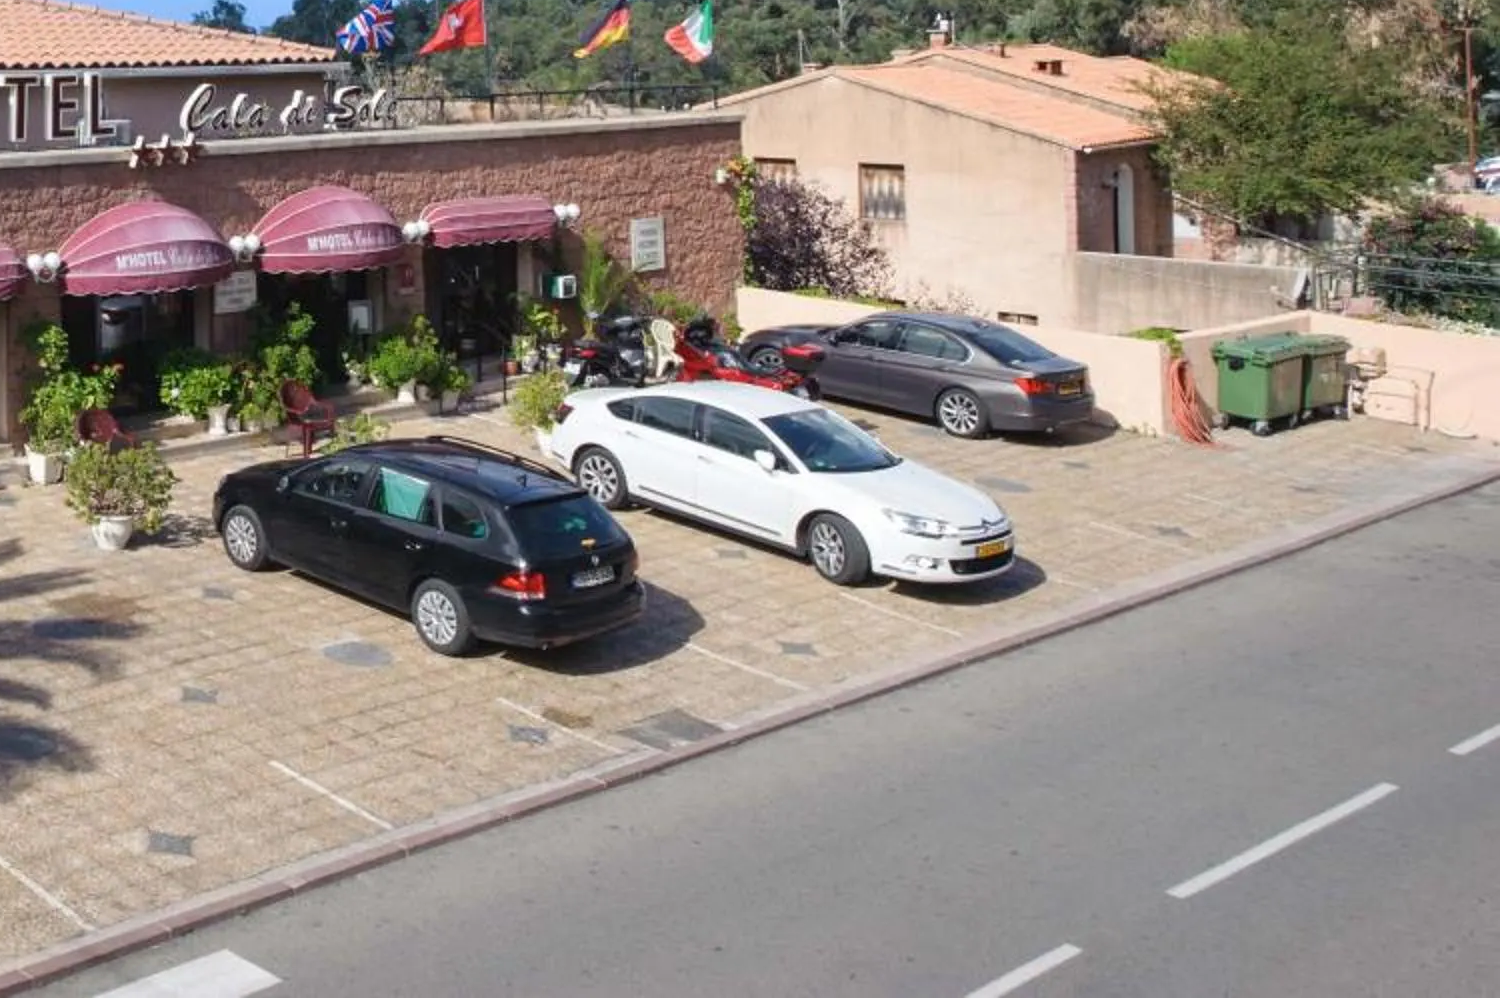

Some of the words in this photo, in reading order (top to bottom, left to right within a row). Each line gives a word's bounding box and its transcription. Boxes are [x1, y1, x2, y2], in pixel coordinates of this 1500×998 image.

[180, 83, 264, 131] Cala
[280, 90, 317, 125] di
[326, 85, 398, 128] Sole
